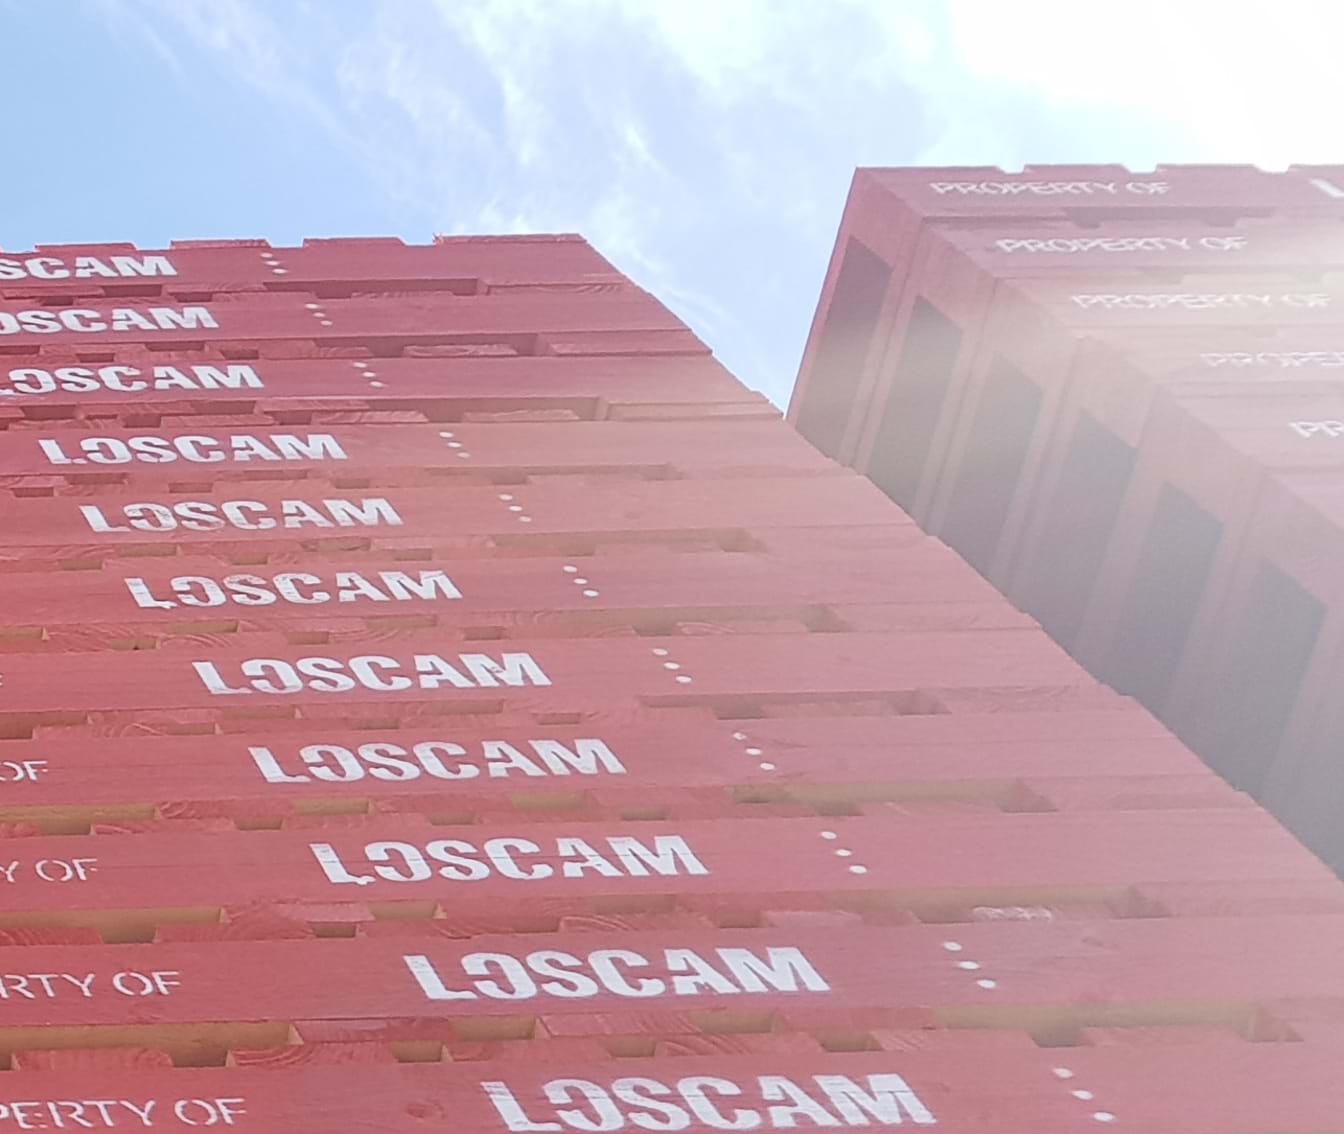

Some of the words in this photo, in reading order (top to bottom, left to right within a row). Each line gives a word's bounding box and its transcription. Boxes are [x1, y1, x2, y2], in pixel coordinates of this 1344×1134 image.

[929, 181, 1117, 195] PROPERTY
[39, 435, 347, 464] LOSCAM
[80, 499, 402, 531] LOSCAM
[125, 571, 462, 608] LOSCAM
[192, 653, 552, 694] LOSCAM
[248, 739, 626, 782] LOSCAM
[36, 859, 96, 881] OF
[310, 836, 709, 885] LOSCAM
[113, 972, 180, 995] OF
[404, 947, 830, 999] LOSCAM
[175, 1099, 246, 1125] OF
[481, 1074, 936, 1131] LOSCAM
